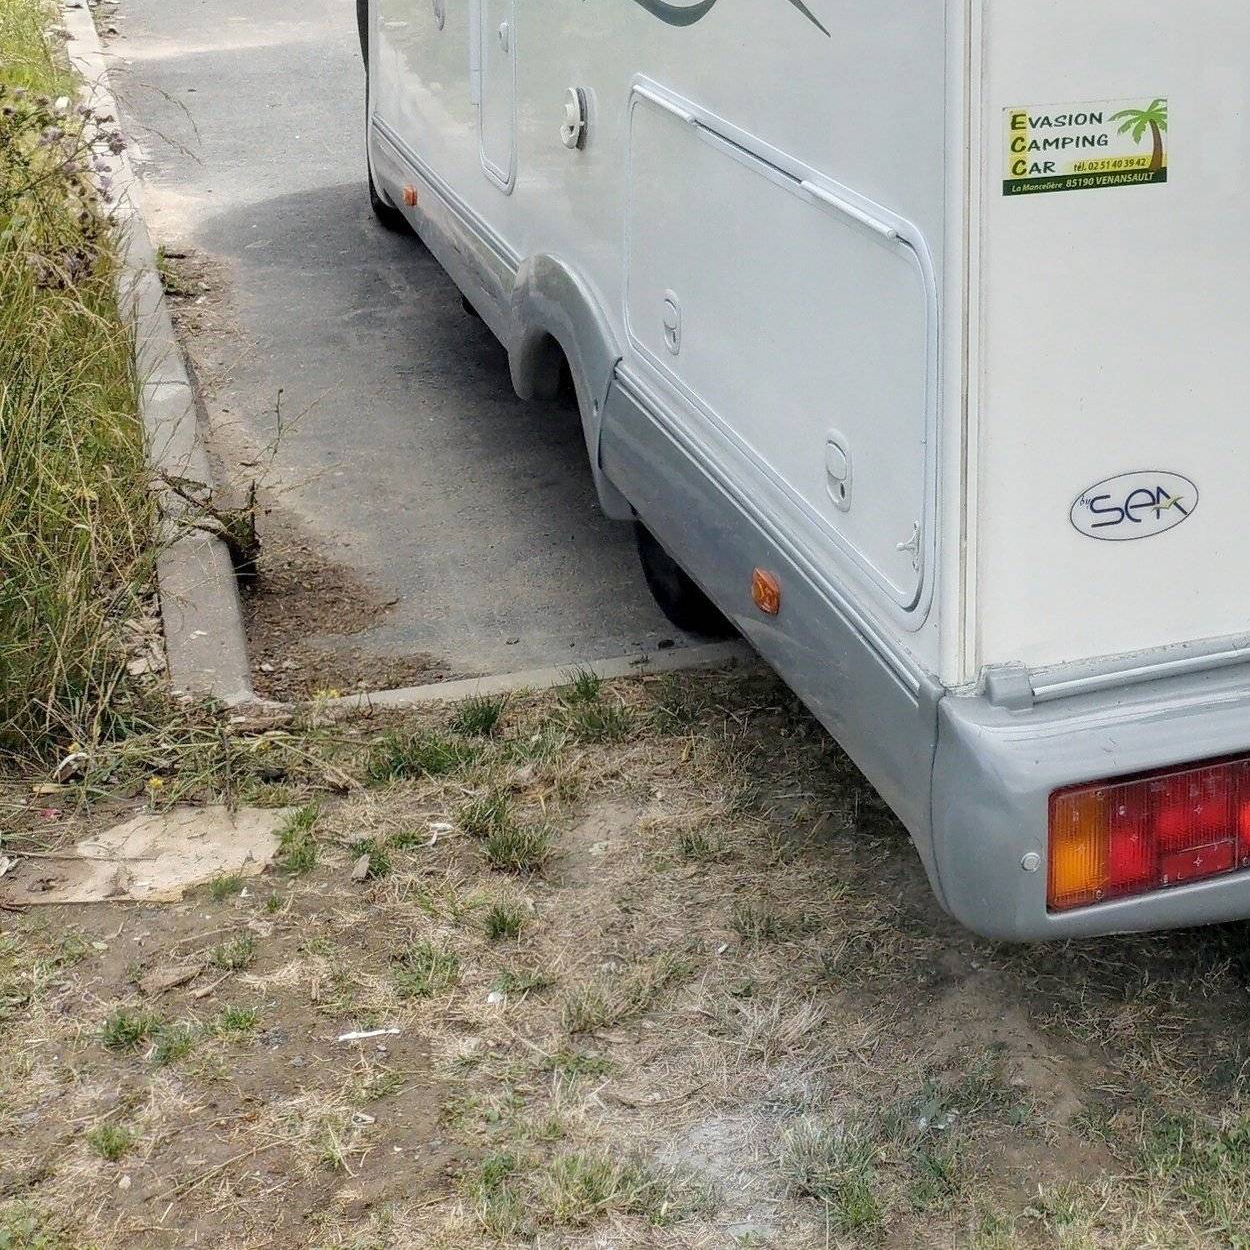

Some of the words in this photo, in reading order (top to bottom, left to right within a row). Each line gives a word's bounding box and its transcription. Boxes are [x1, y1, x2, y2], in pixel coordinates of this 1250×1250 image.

[1011, 112, 1103, 130] EVASION
[1010, 134, 1108, 153] CAMPING
[1011, 159, 1056, 176] CAR
[1088, 161, 1099, 170] 02
[1100, 160, 1110, 170] 51
[1111, 160, 1122, 169] 40
[1124, 158, 1134, 168] 39
[1135, 158, 1146, 167] 42
[1066, 177, 1094, 188] 85190
[1096, 172, 1155, 185] VENANSAULT
